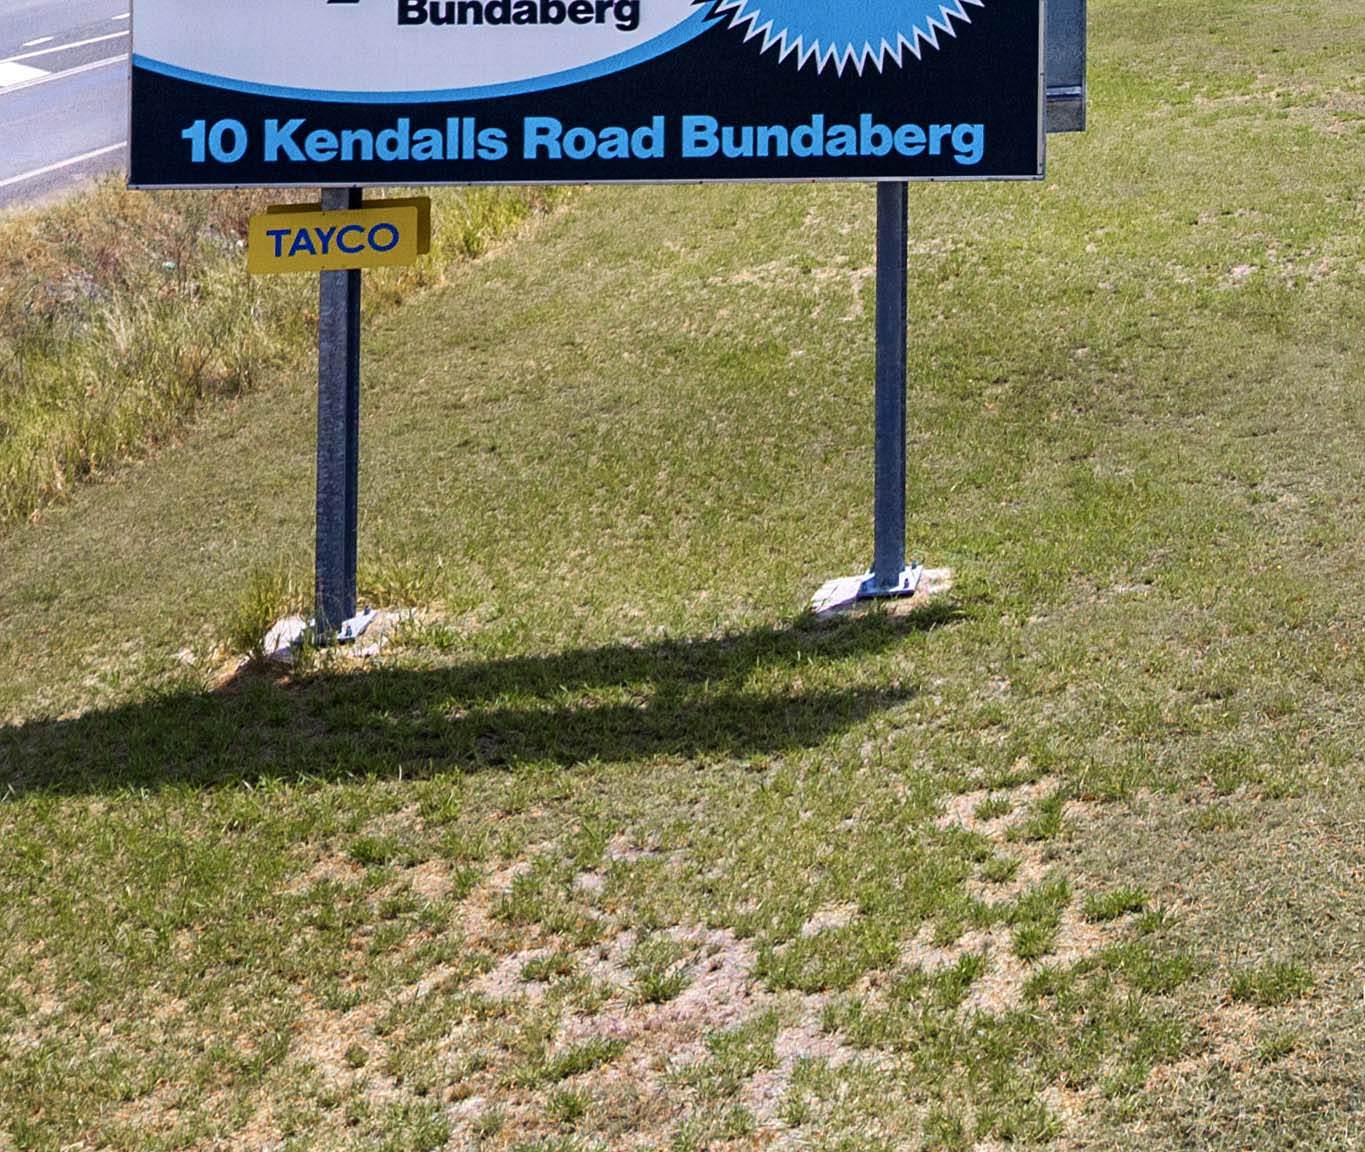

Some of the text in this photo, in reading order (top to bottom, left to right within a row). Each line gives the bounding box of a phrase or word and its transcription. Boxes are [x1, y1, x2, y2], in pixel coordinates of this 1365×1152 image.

[182, 113, 985, 166] 10 Kendalls Road Bundaberg
[266, 223, 400, 257] TAYCO
